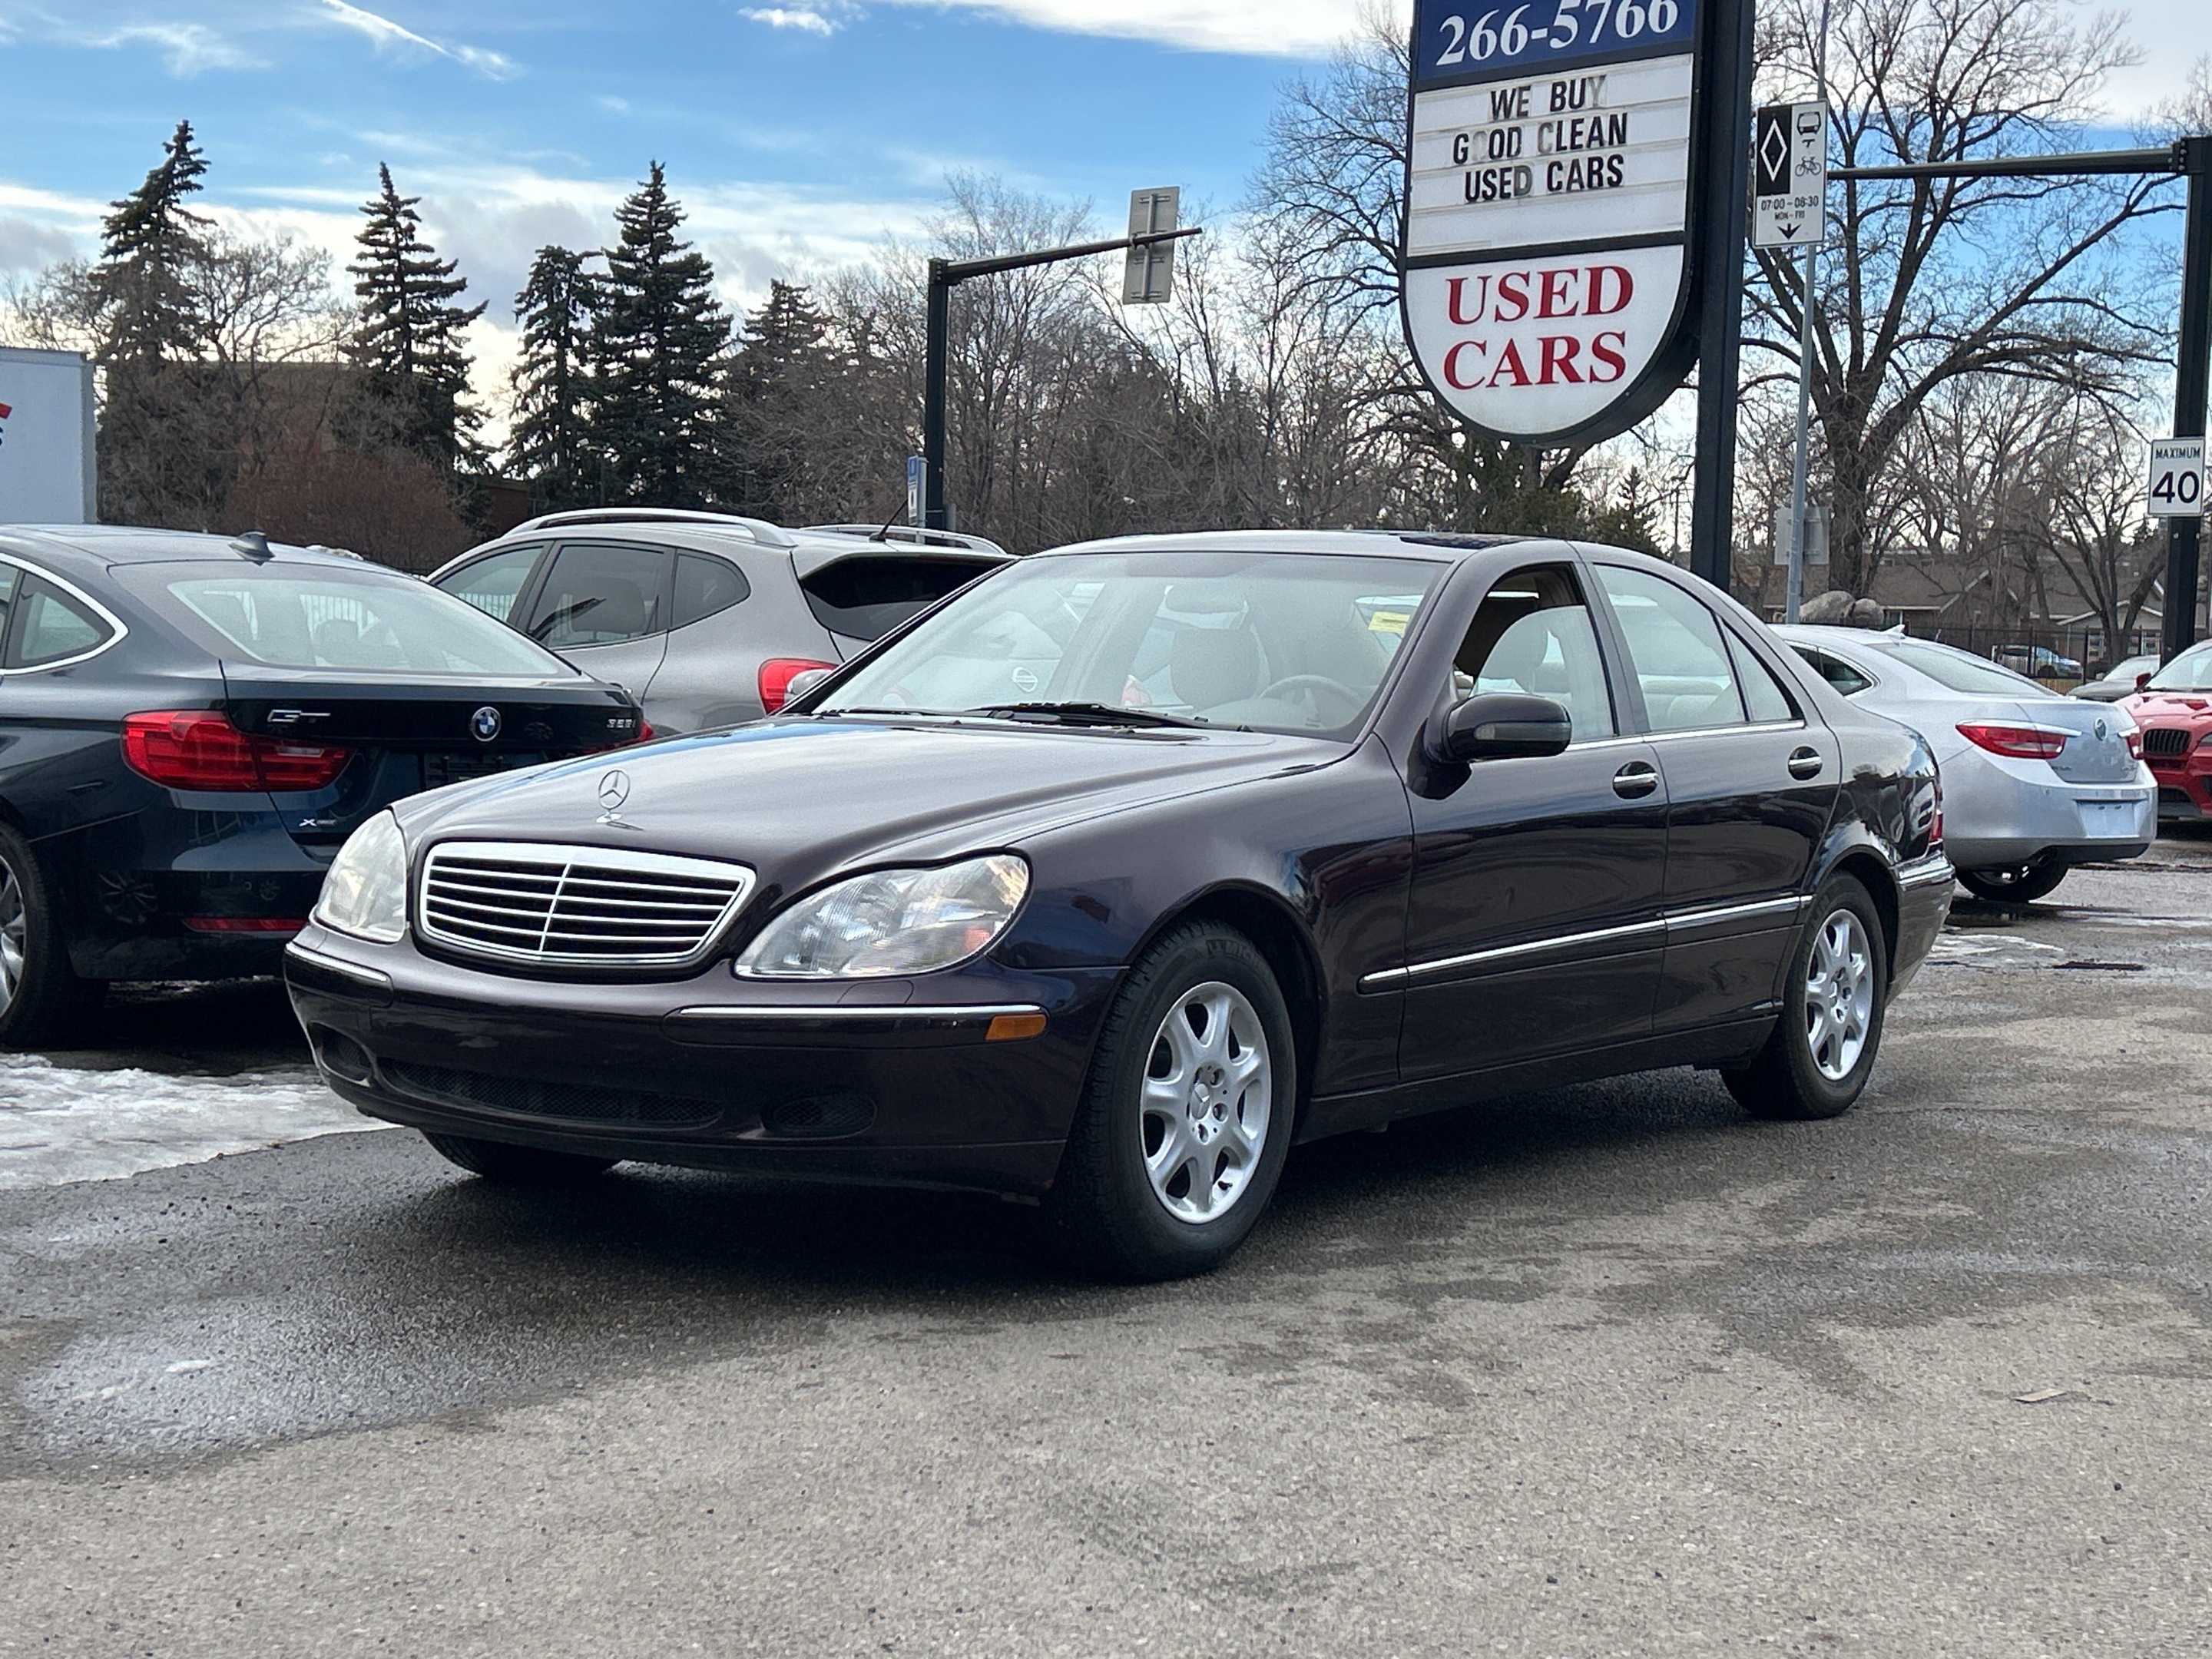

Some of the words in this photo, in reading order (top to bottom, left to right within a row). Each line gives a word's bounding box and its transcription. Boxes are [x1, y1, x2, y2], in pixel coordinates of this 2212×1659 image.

[1435, 0, 1679, 66] 266-5766
[1490, 84, 1532, 121] WE
[1549, 74, 1608, 112] BUY
[1537, 112, 1628, 155] CLEAN
[1465, 164, 1533, 202] USED
[1546, 153, 1624, 193] CARS
[1445, 264, 1634, 326] USED
[1443, 329, 1627, 390] CARS
[2154, 446, 2201, 459] MAXIMUM
[2151, 470, 2200, 504] 40
